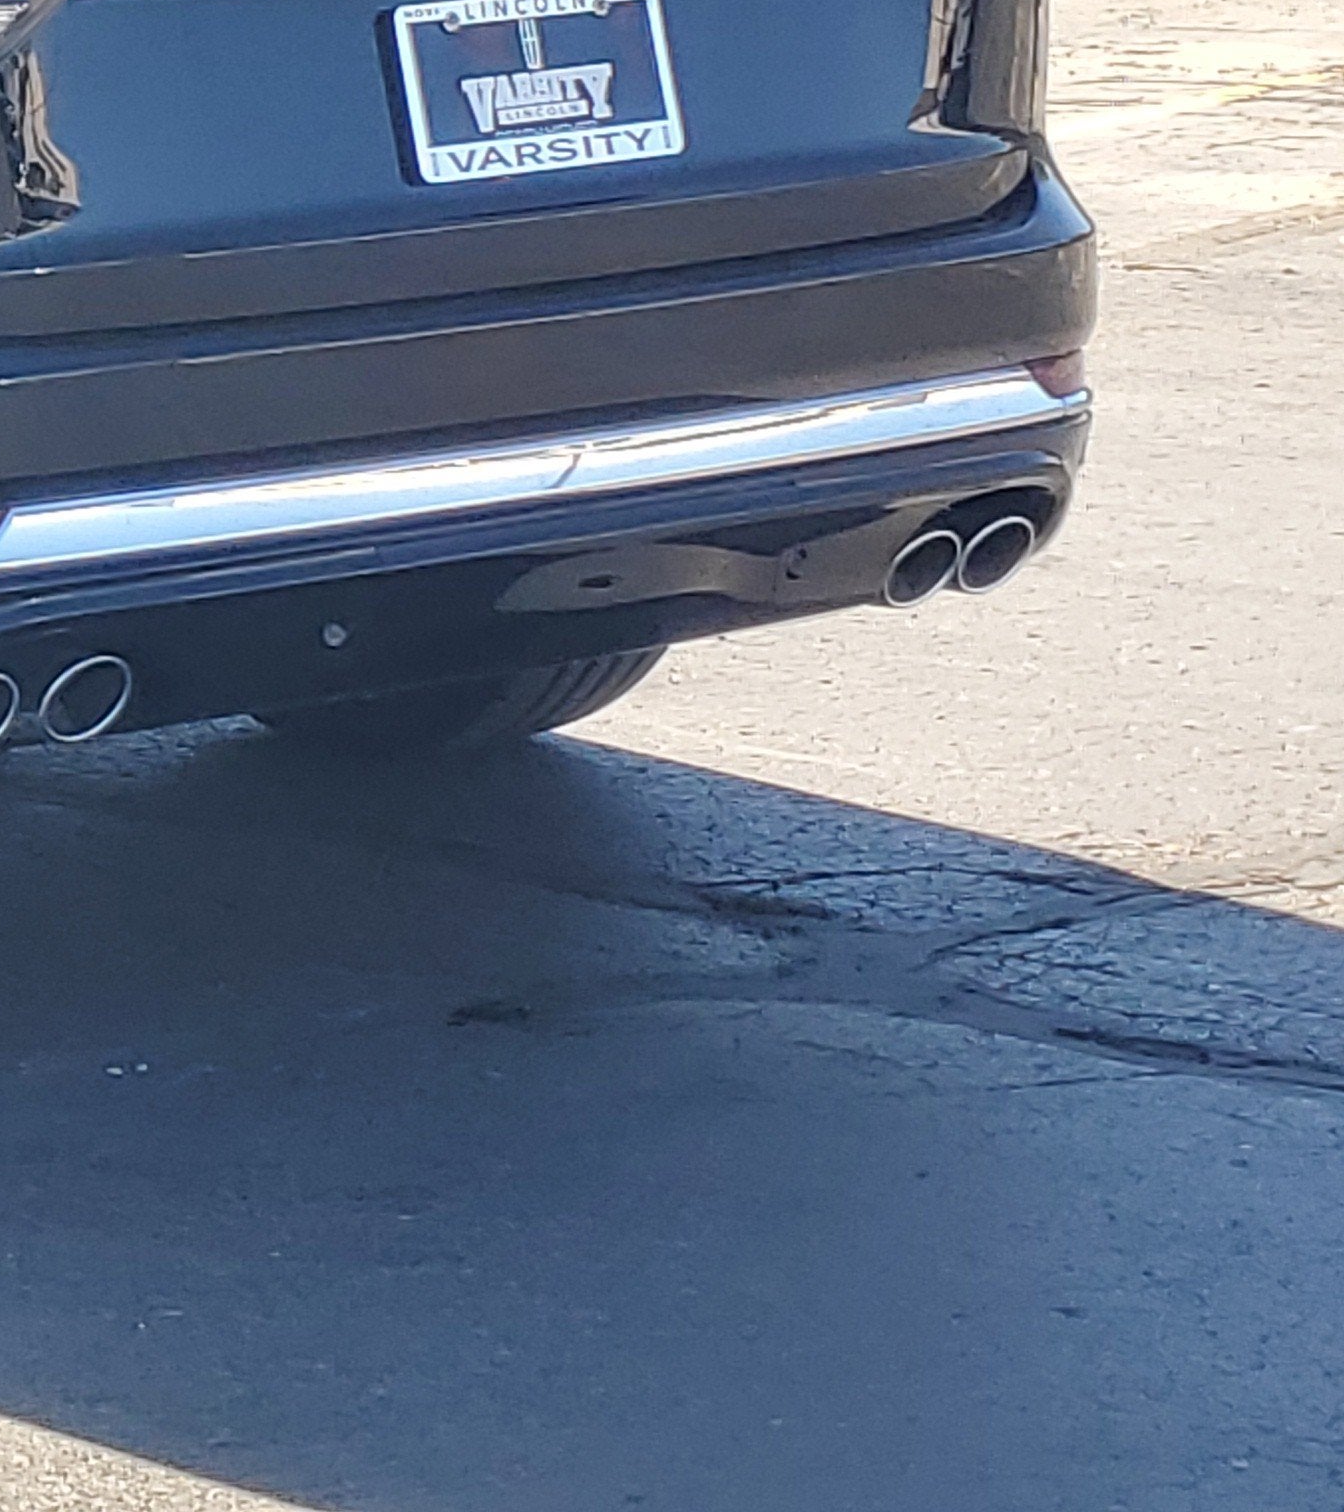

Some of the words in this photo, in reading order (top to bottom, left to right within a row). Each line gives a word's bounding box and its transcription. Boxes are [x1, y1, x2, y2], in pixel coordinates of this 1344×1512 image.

[460, 62, 613, 134] VARSITY
[504, 104, 581, 121] LINCOLN
[447, 128, 653, 174] VARSITY
